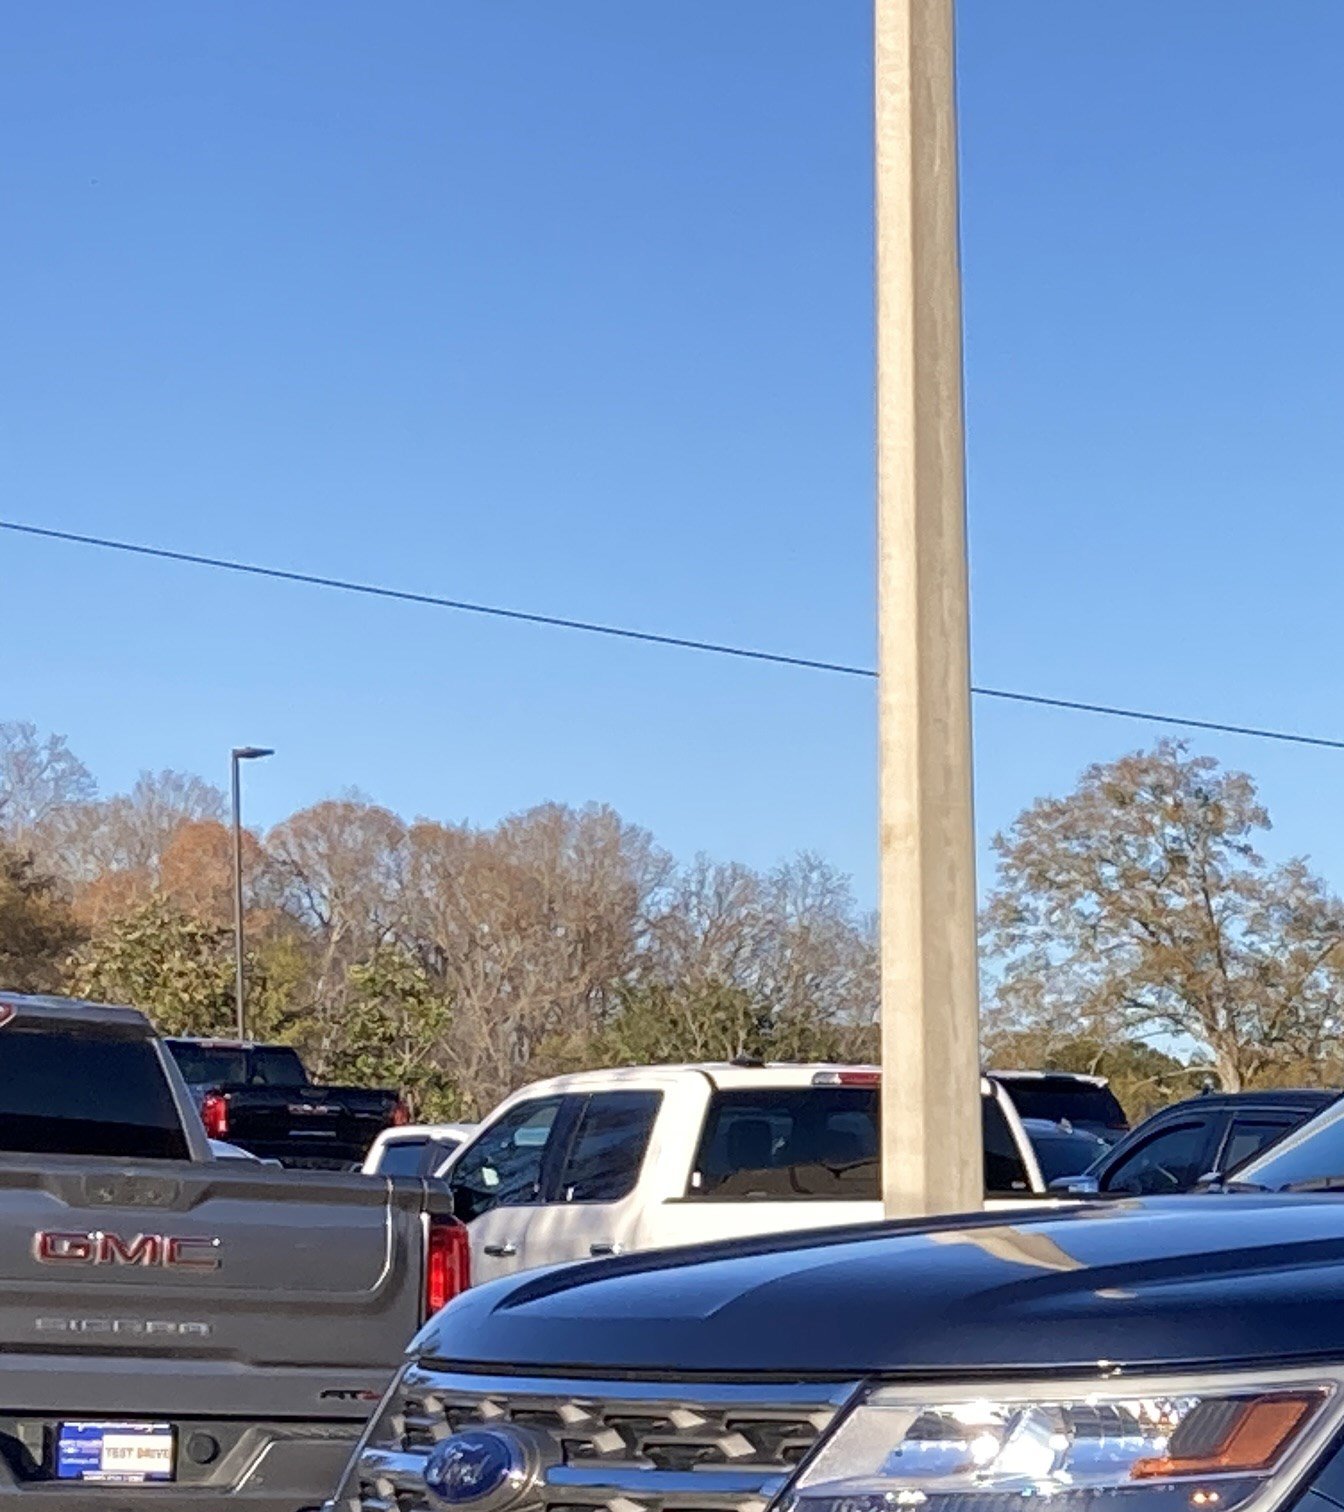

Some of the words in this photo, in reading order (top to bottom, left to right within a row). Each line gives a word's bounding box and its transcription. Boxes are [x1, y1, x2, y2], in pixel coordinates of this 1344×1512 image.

[35, 1231, 222, 1270] GMC
[35, 1318, 211, 1335] SIERRA
[105, 1447, 134, 1459] TEST
